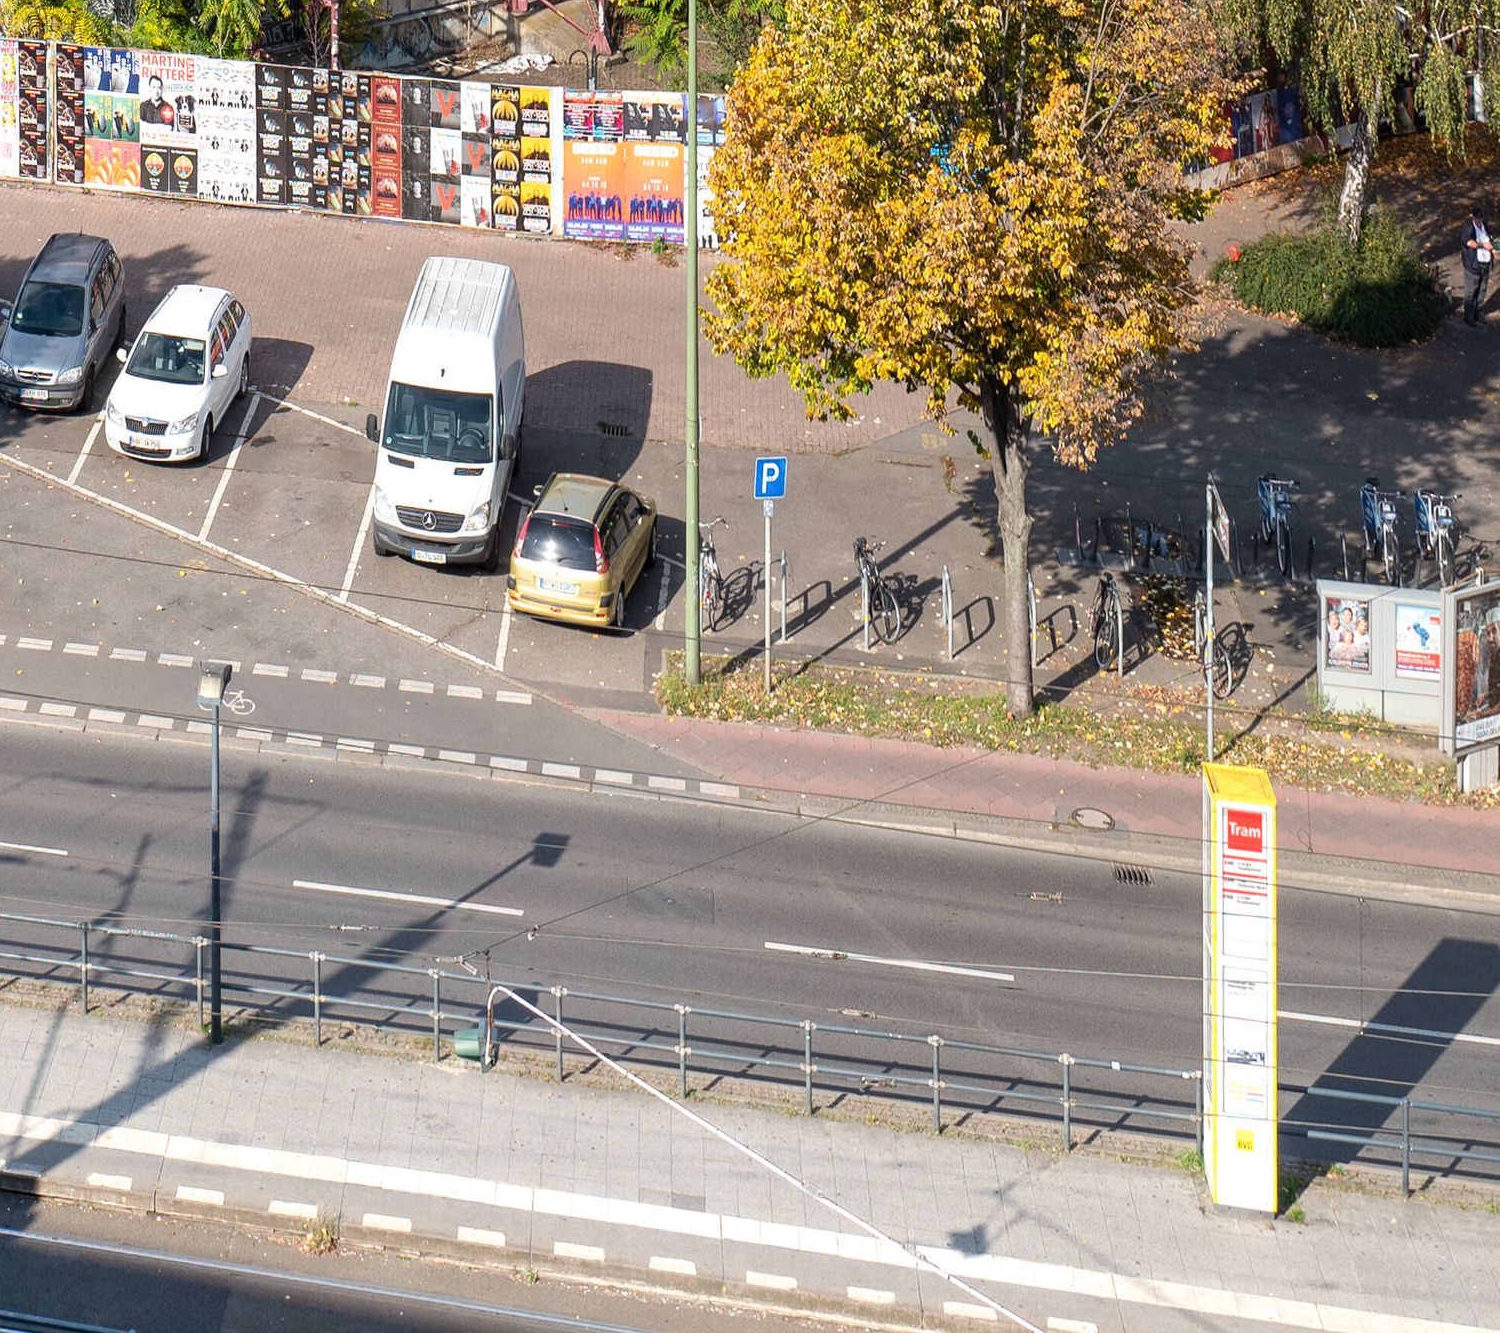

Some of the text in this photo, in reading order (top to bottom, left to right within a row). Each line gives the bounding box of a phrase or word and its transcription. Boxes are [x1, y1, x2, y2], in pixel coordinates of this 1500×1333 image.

[141, 54, 186, 69] MARTIN
[186, 57, 195, 83] LIVE
[761, 462, 780, 494] P
[1228, 821, 1262, 839] Tram
[1237, 1140, 1254, 1151] BVG
